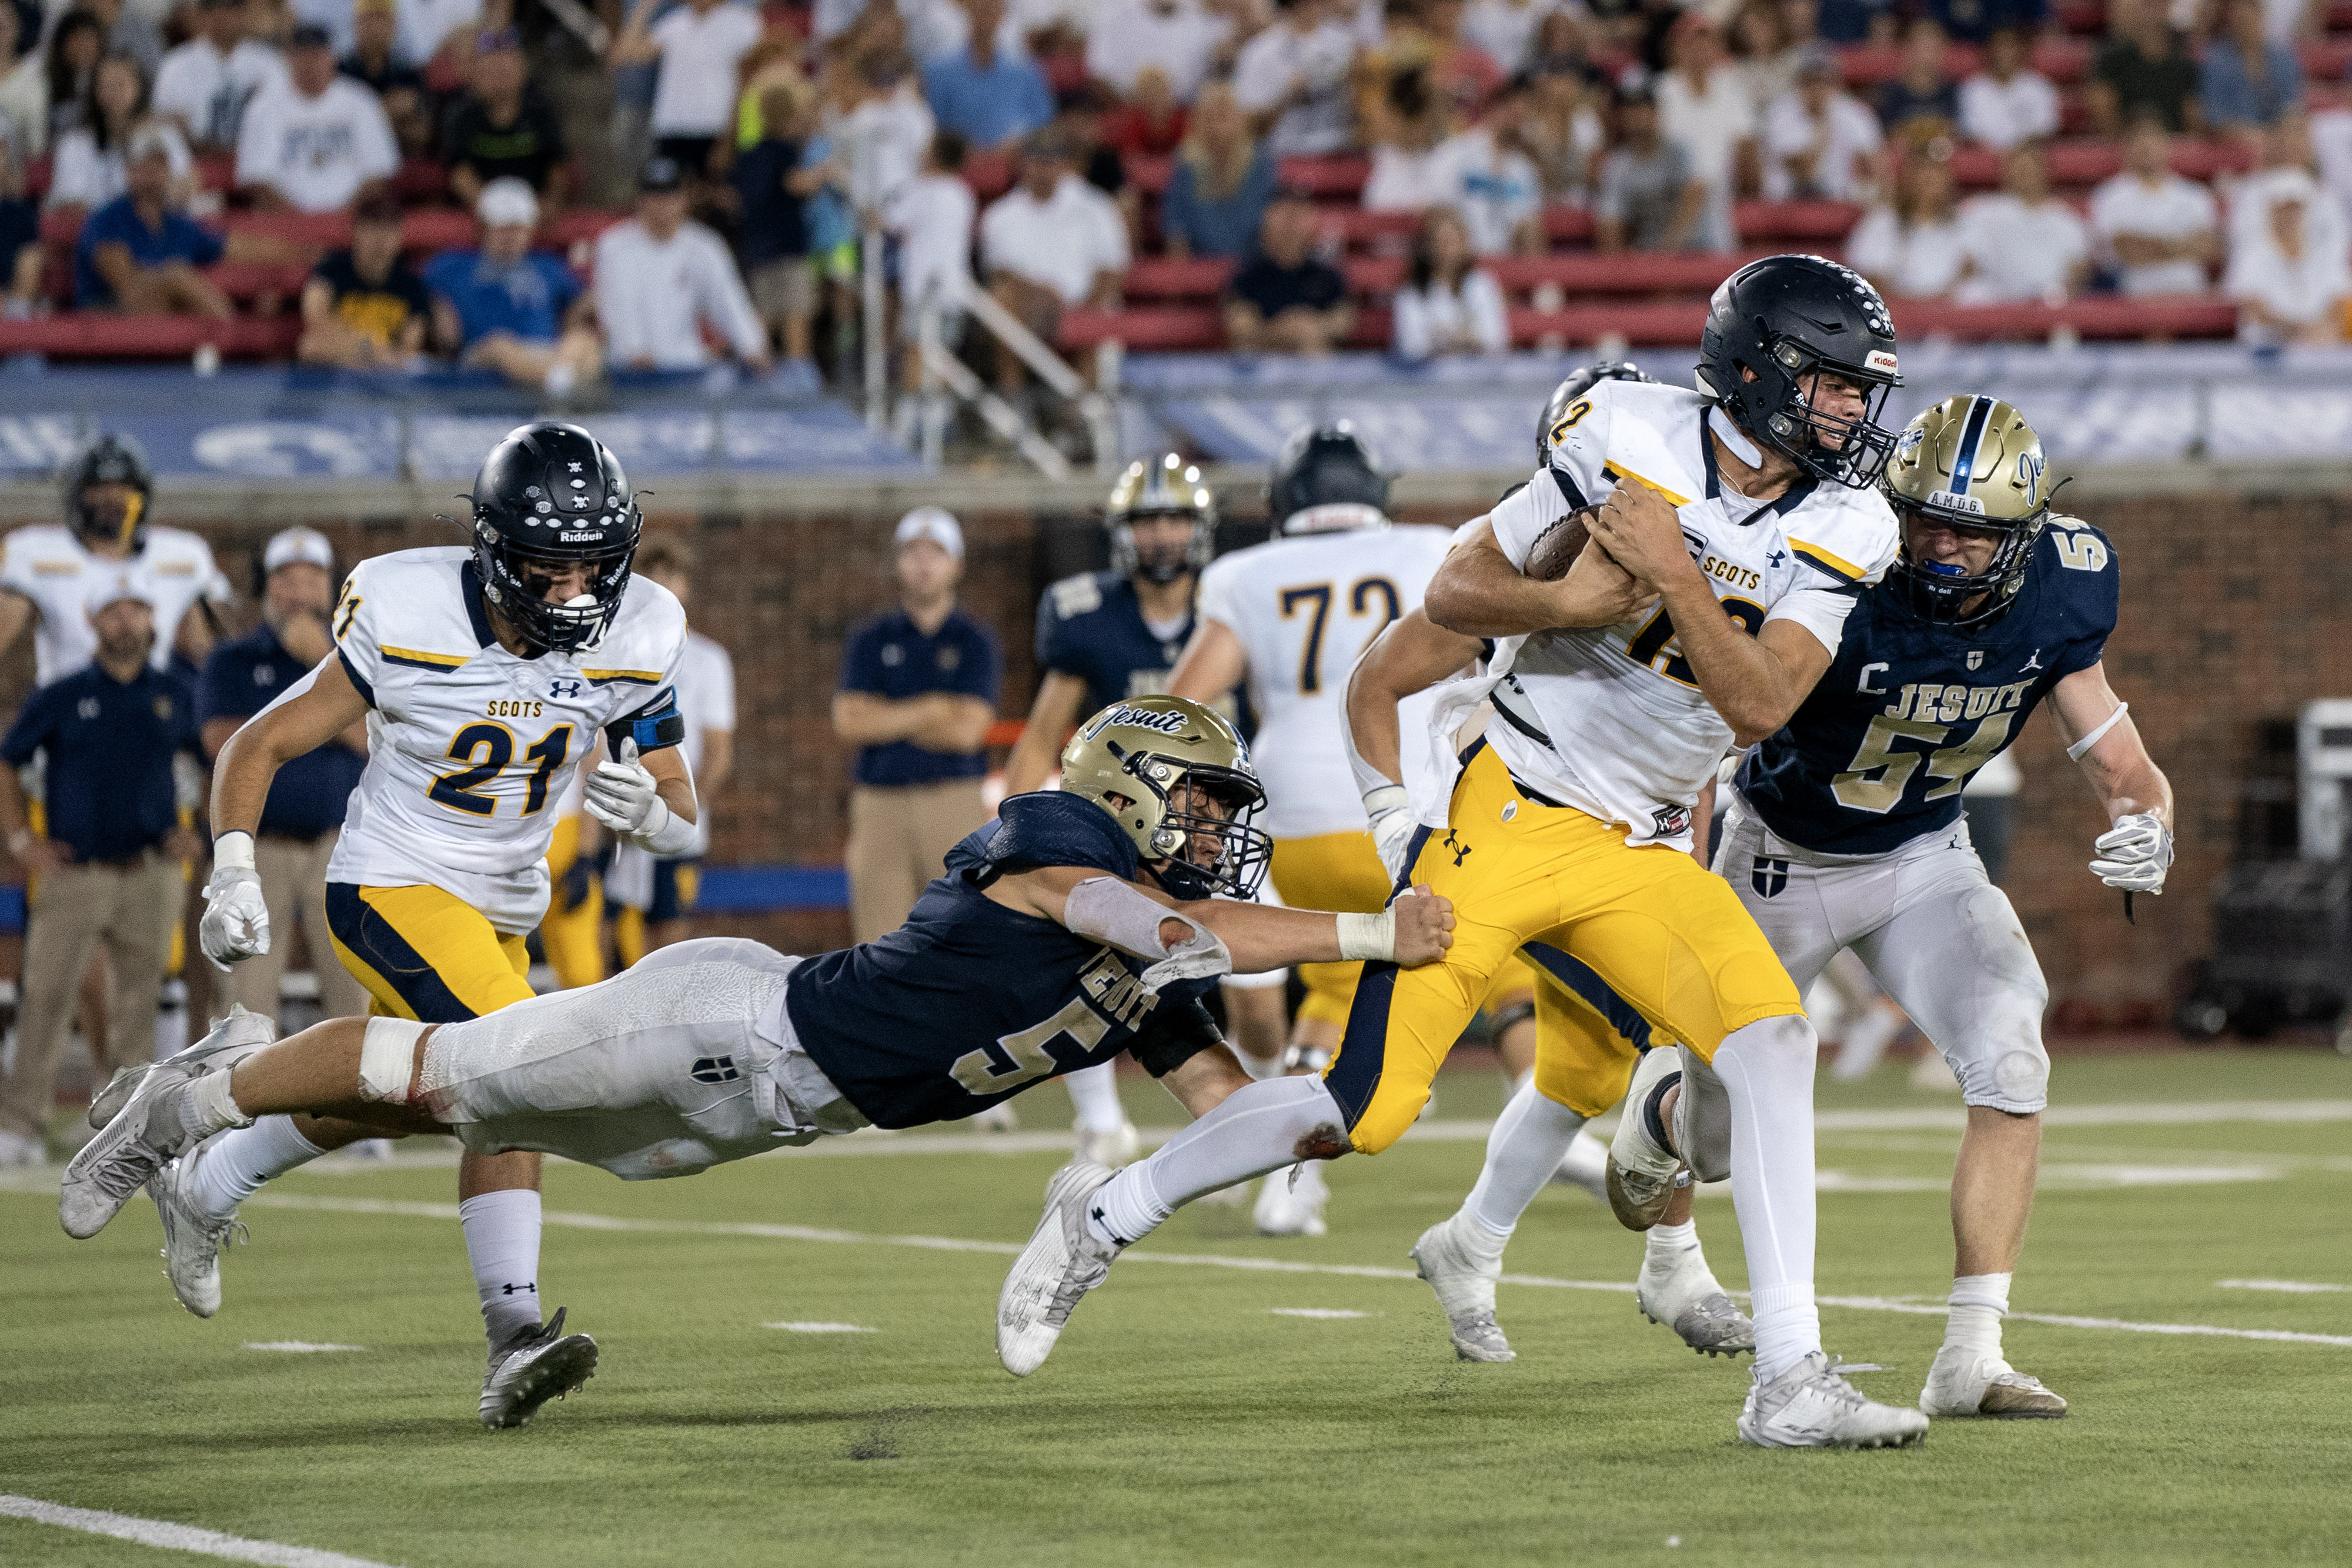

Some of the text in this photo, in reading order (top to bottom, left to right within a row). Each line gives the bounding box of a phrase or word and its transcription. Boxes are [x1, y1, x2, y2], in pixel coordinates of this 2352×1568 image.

[1931, 493, 1980, 513] A.M.D.G.
[1703, 556, 1761, 590] SCOTS
[1856, 661, 1889, 696] C
[487, 700, 543, 717] SCOTS
[1884, 677, 2039, 722] JESUIT
[1084, 704, 1189, 743] Jesuit
[426, 720, 575, 818] 21
[1830, 710, 2017, 814] 54
[948, 995, 1111, 1095] 5
